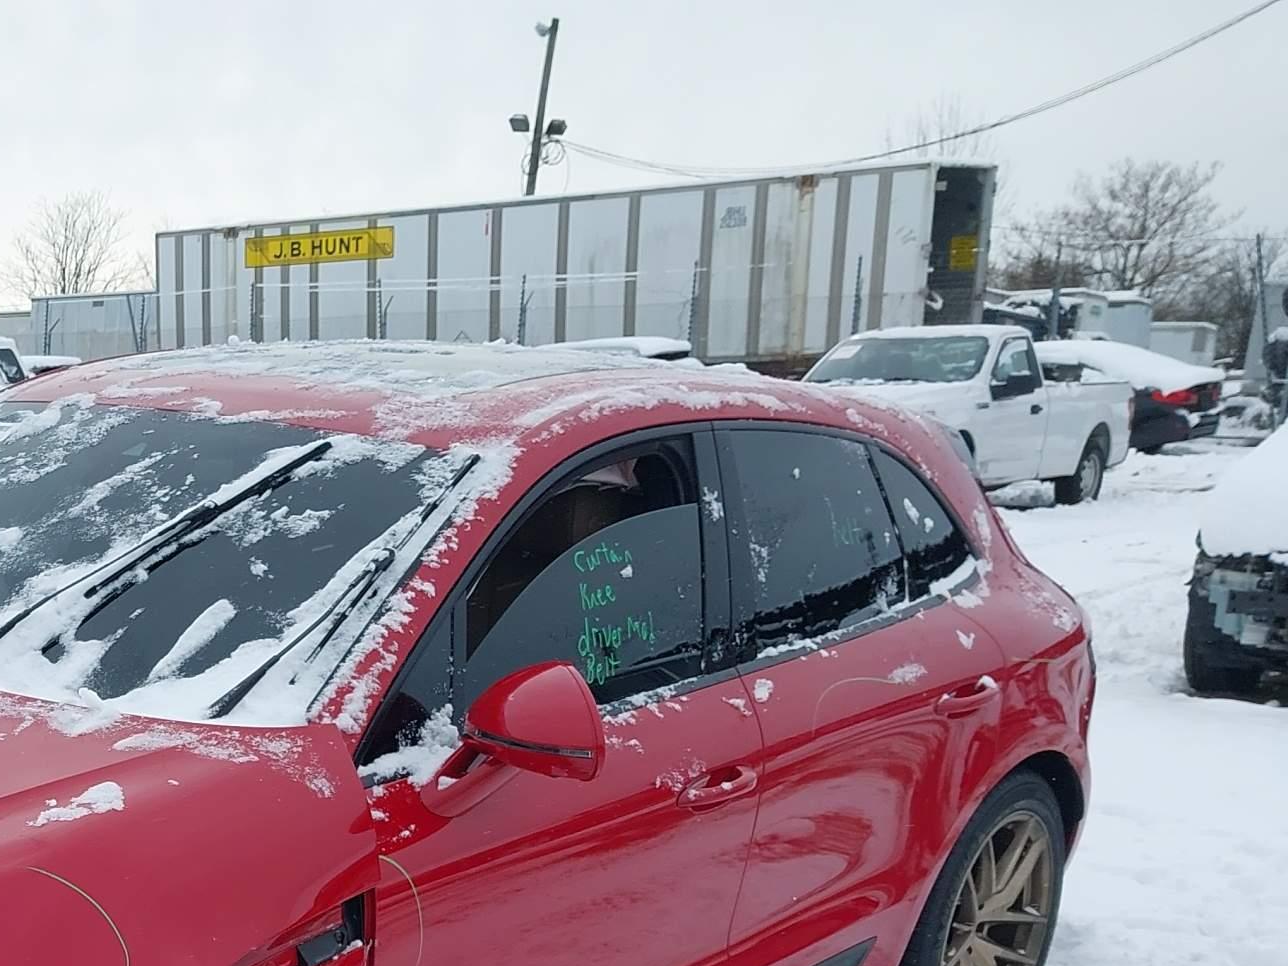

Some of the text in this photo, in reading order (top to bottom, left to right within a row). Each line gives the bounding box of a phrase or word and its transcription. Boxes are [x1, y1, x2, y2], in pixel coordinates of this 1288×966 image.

[311, 236, 364, 257] HUNT
[574, 542, 633, 573] Curtain
[579, 583, 616, 610] Knee
[577, 617, 622, 657] driver
[586, 653, 621, 686] Belt
